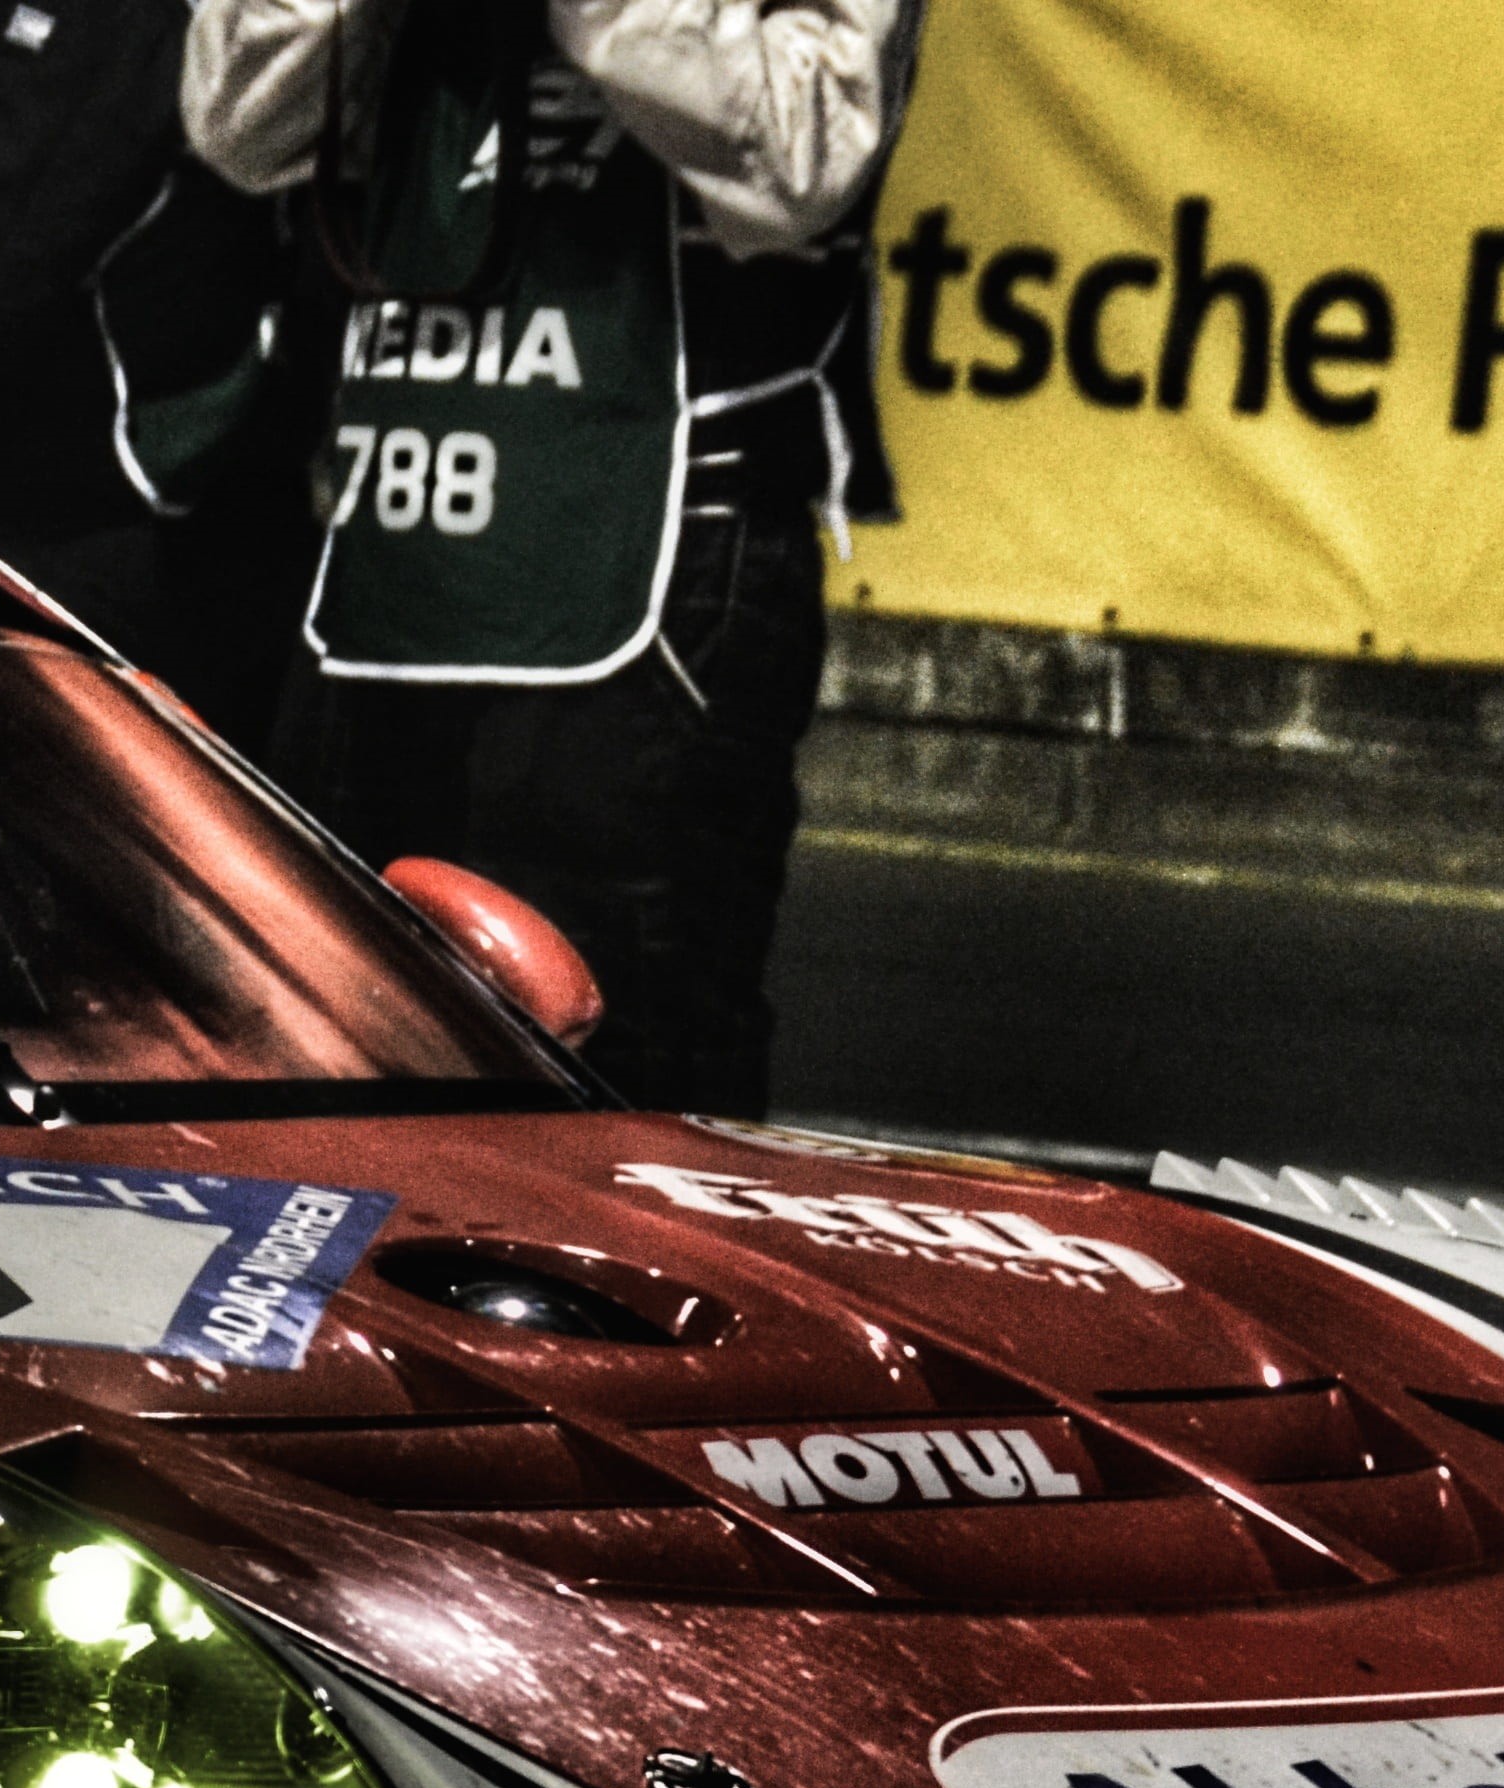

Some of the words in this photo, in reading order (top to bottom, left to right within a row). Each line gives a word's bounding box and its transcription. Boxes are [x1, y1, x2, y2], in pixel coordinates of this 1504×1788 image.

[889, 195, 1394, 431] tsche
[333, 424, 498, 536] 788
[237, 1184, 354, 1281] NORDRHEIN
[201, 1274, 290, 1361] ADAC
[699, 1428, 1082, 1510] MOTUL
